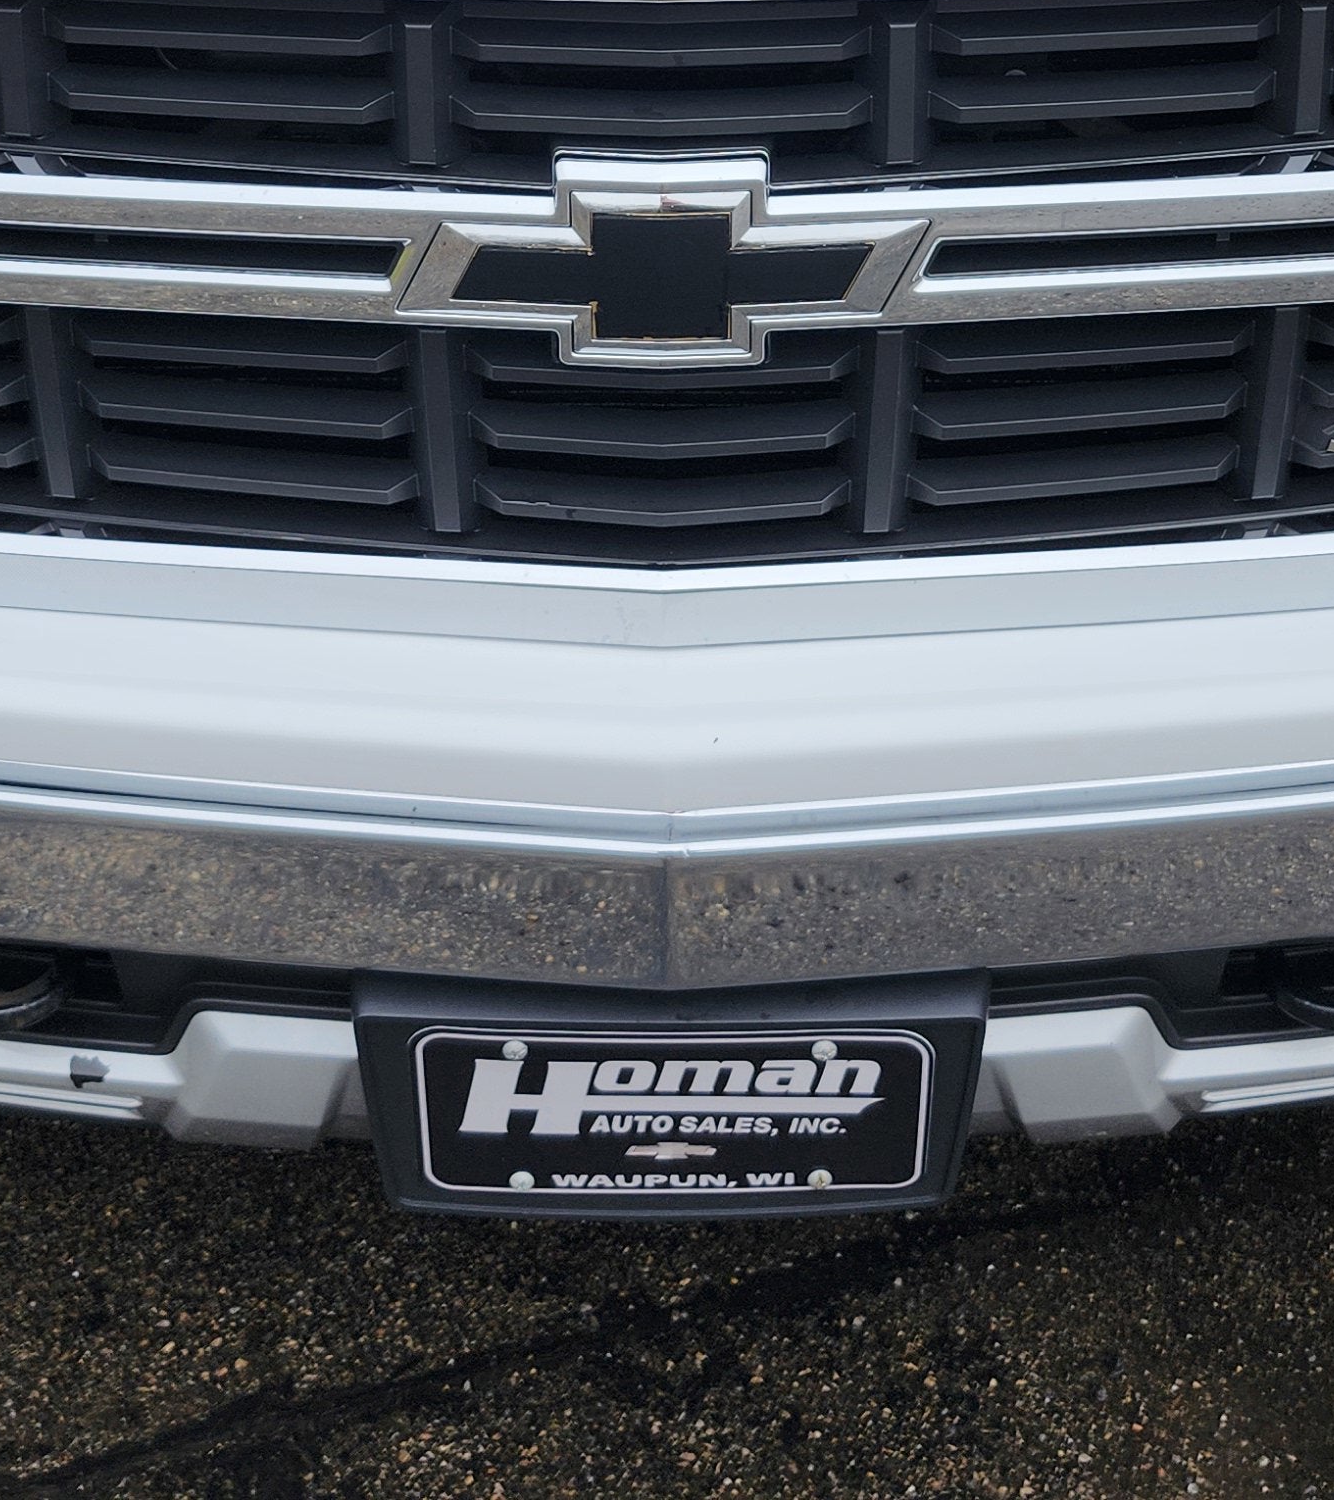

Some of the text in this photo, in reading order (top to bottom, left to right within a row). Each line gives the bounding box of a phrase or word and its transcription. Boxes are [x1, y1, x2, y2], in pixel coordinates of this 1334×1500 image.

[458, 1058, 886, 1135] Homan
[589, 1114, 847, 1136] AUTO SALES, INC.
[551, 1172, 795, 1188] WAUPUN, WI
